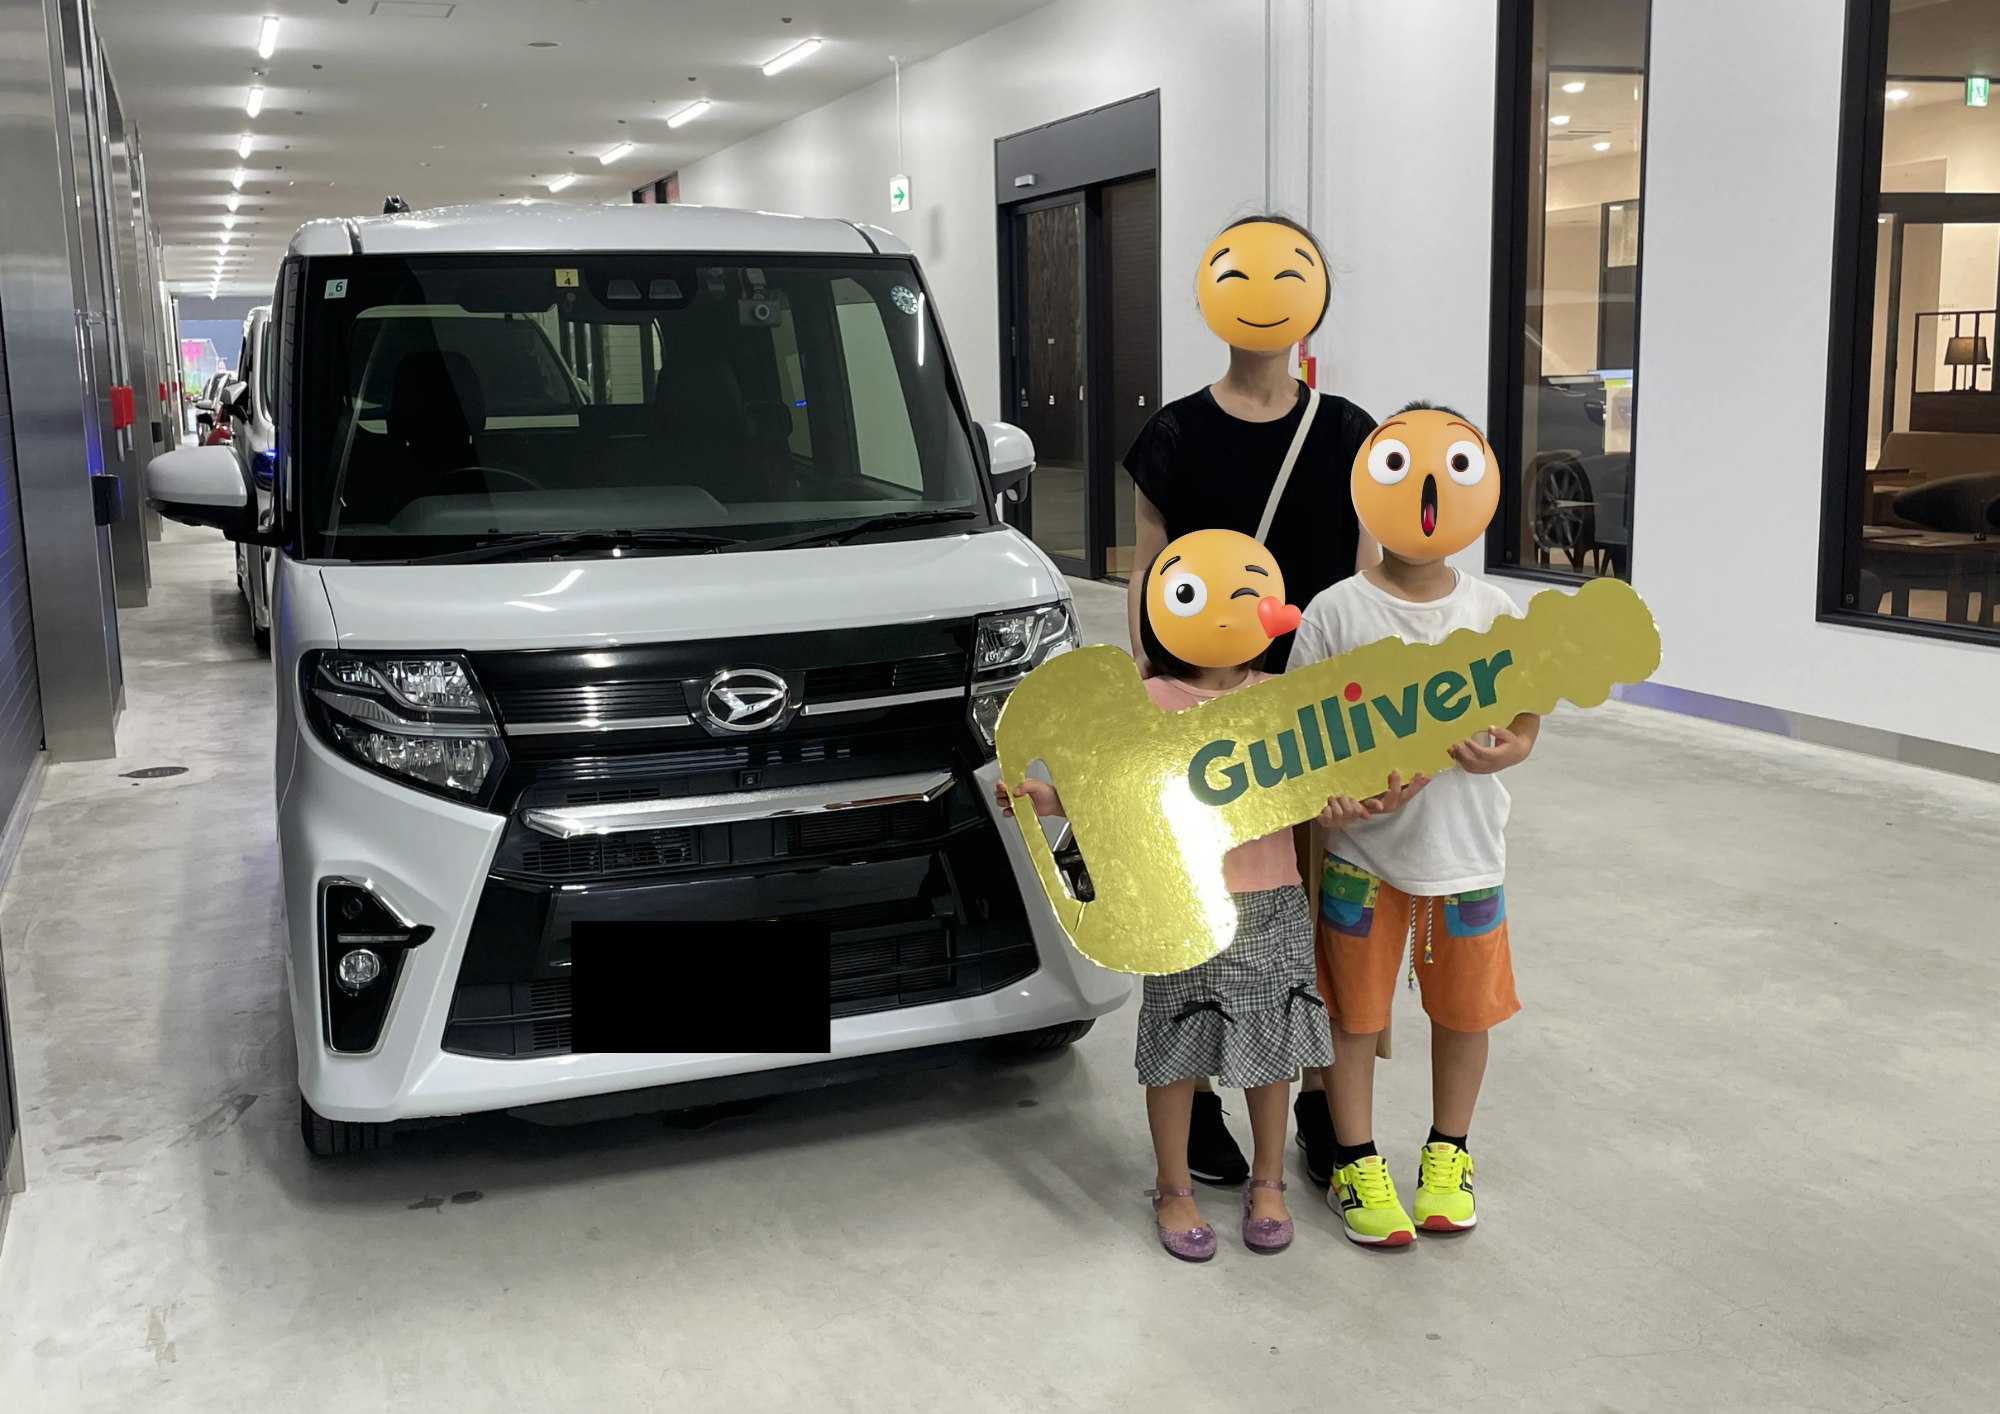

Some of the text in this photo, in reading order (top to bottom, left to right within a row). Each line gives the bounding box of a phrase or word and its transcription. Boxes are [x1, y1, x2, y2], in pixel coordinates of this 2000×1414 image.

[335, 281, 343, 293] 6
[564, 277, 571, 285] 4
[1188, 649, 1513, 806] Gulliver
